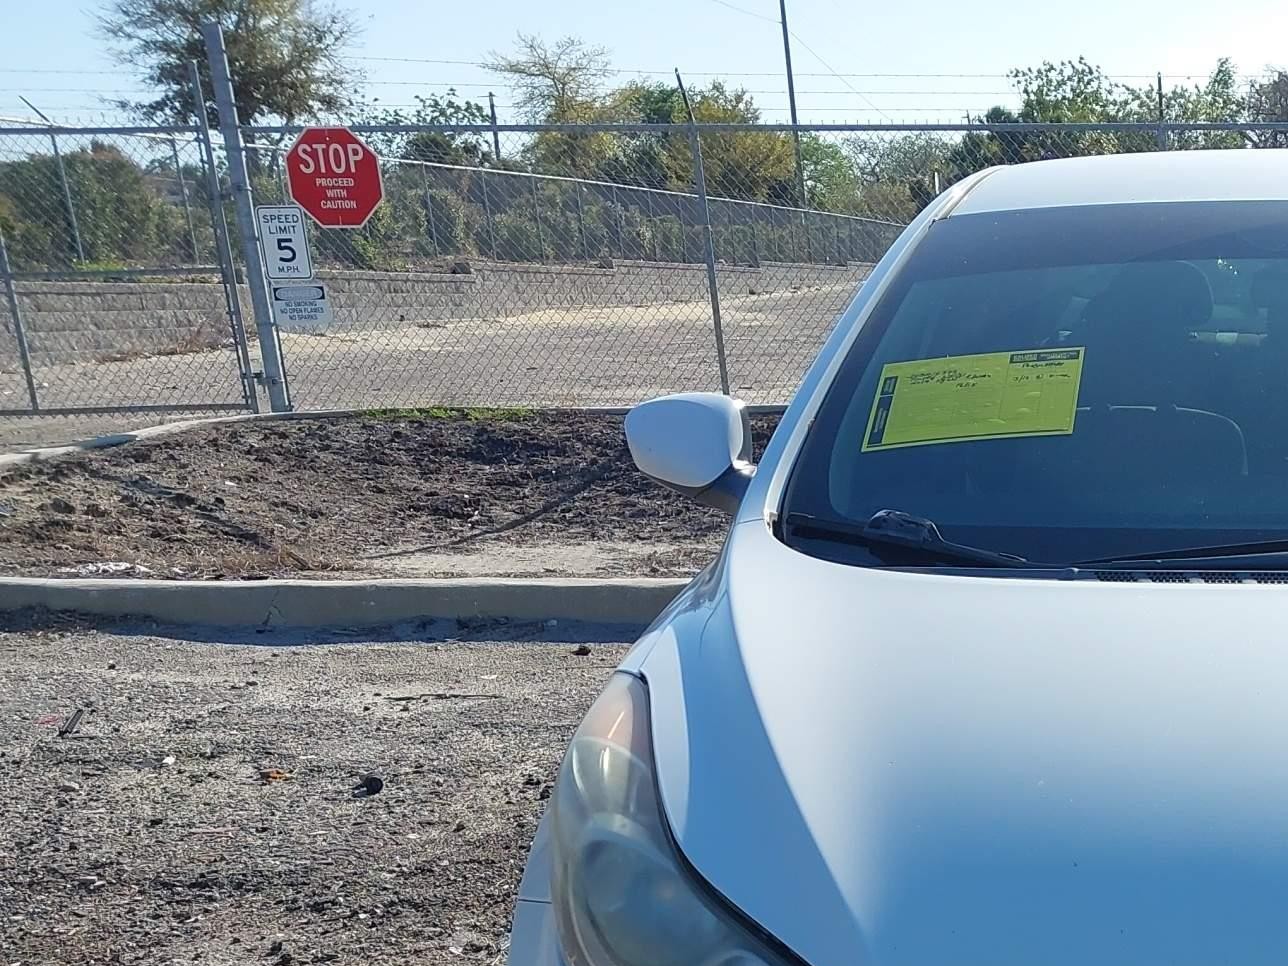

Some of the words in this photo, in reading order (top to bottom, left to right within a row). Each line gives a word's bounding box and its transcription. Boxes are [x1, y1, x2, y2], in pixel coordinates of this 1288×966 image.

[297, 143, 364, 174] STOP
[315, 177, 355, 187] PROCEED
[326, 189, 348, 198] WITH
[320, 200, 357, 209] CAUTION
[262, 213, 300, 224] SPEED
[268, 225, 297, 235] LIMIT
[277, 238, 297, 262] 5
